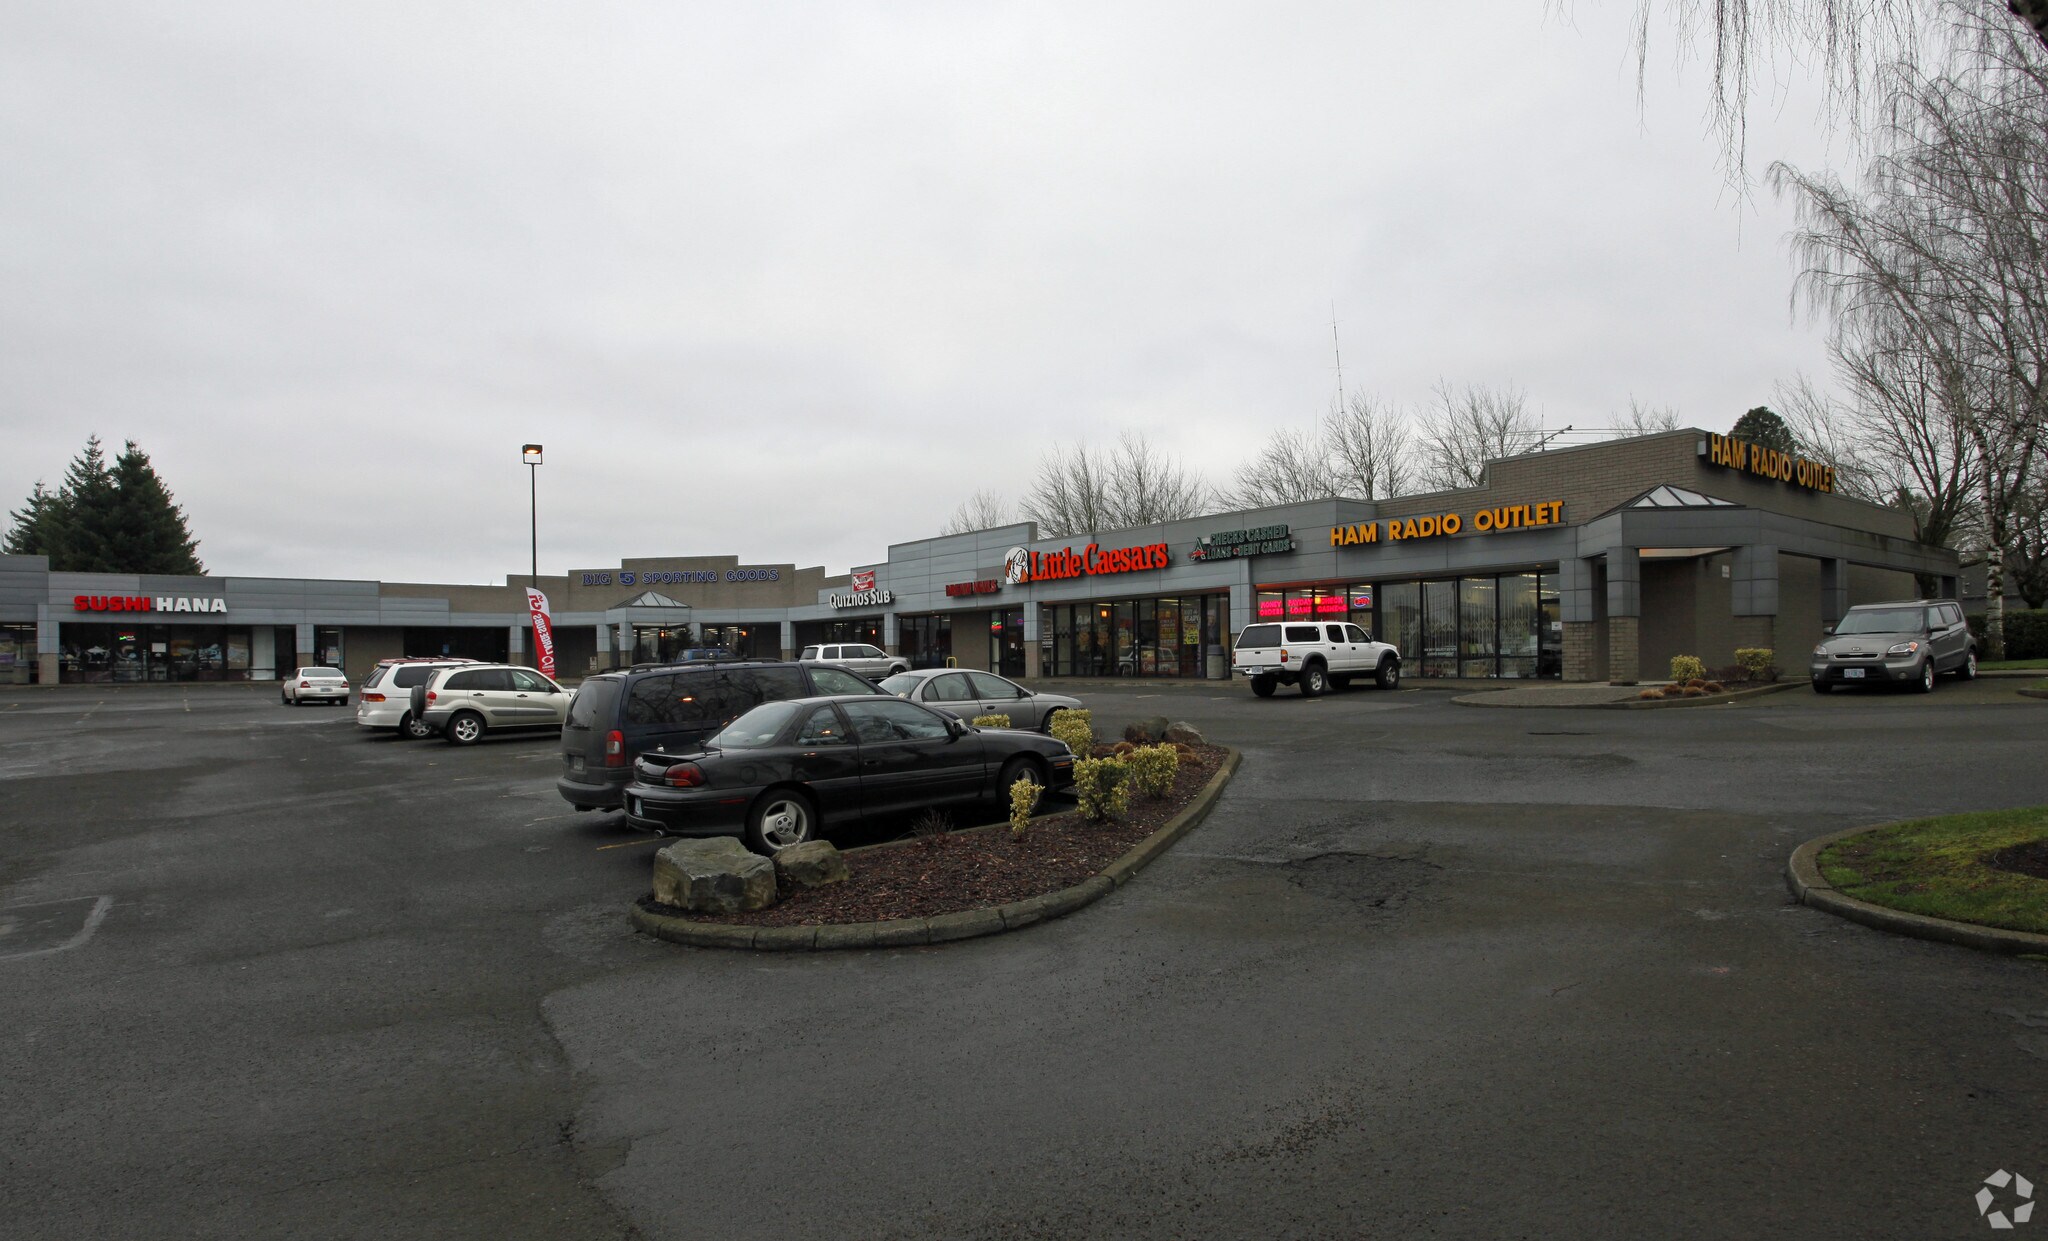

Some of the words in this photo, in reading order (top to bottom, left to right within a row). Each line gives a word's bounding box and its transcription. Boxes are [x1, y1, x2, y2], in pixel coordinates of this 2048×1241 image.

[1710, 432, 1746, 470] HAM
[1751, 443, 1793, 482] RADIO
[1797, 458, 1835, 493] OUTLET
[1330, 522, 1378, 546] HAM
[1388, 513, 1462, 541] RADIO
[1474, 500, 1564, 531] OUTLET
[1209, 530, 1247, 547] CHECKS
[1247, 524, 1288, 541] CASHED
[1207, 546, 1232, 560] LOANS
[1261, 539, 1291, 554] CARDS
[1030, 547, 1082, 581] Little
[1083, 543, 1169, 576] Caesars
[582, 572, 612, 586] BIG
[618, 571, 636, 586] 5
[642, 570, 718, 584] SPORTING
[725, 569, 779, 582] GOODS
[73, 595, 150, 612] SUSHI
[156, 597, 227, 613] HANA
